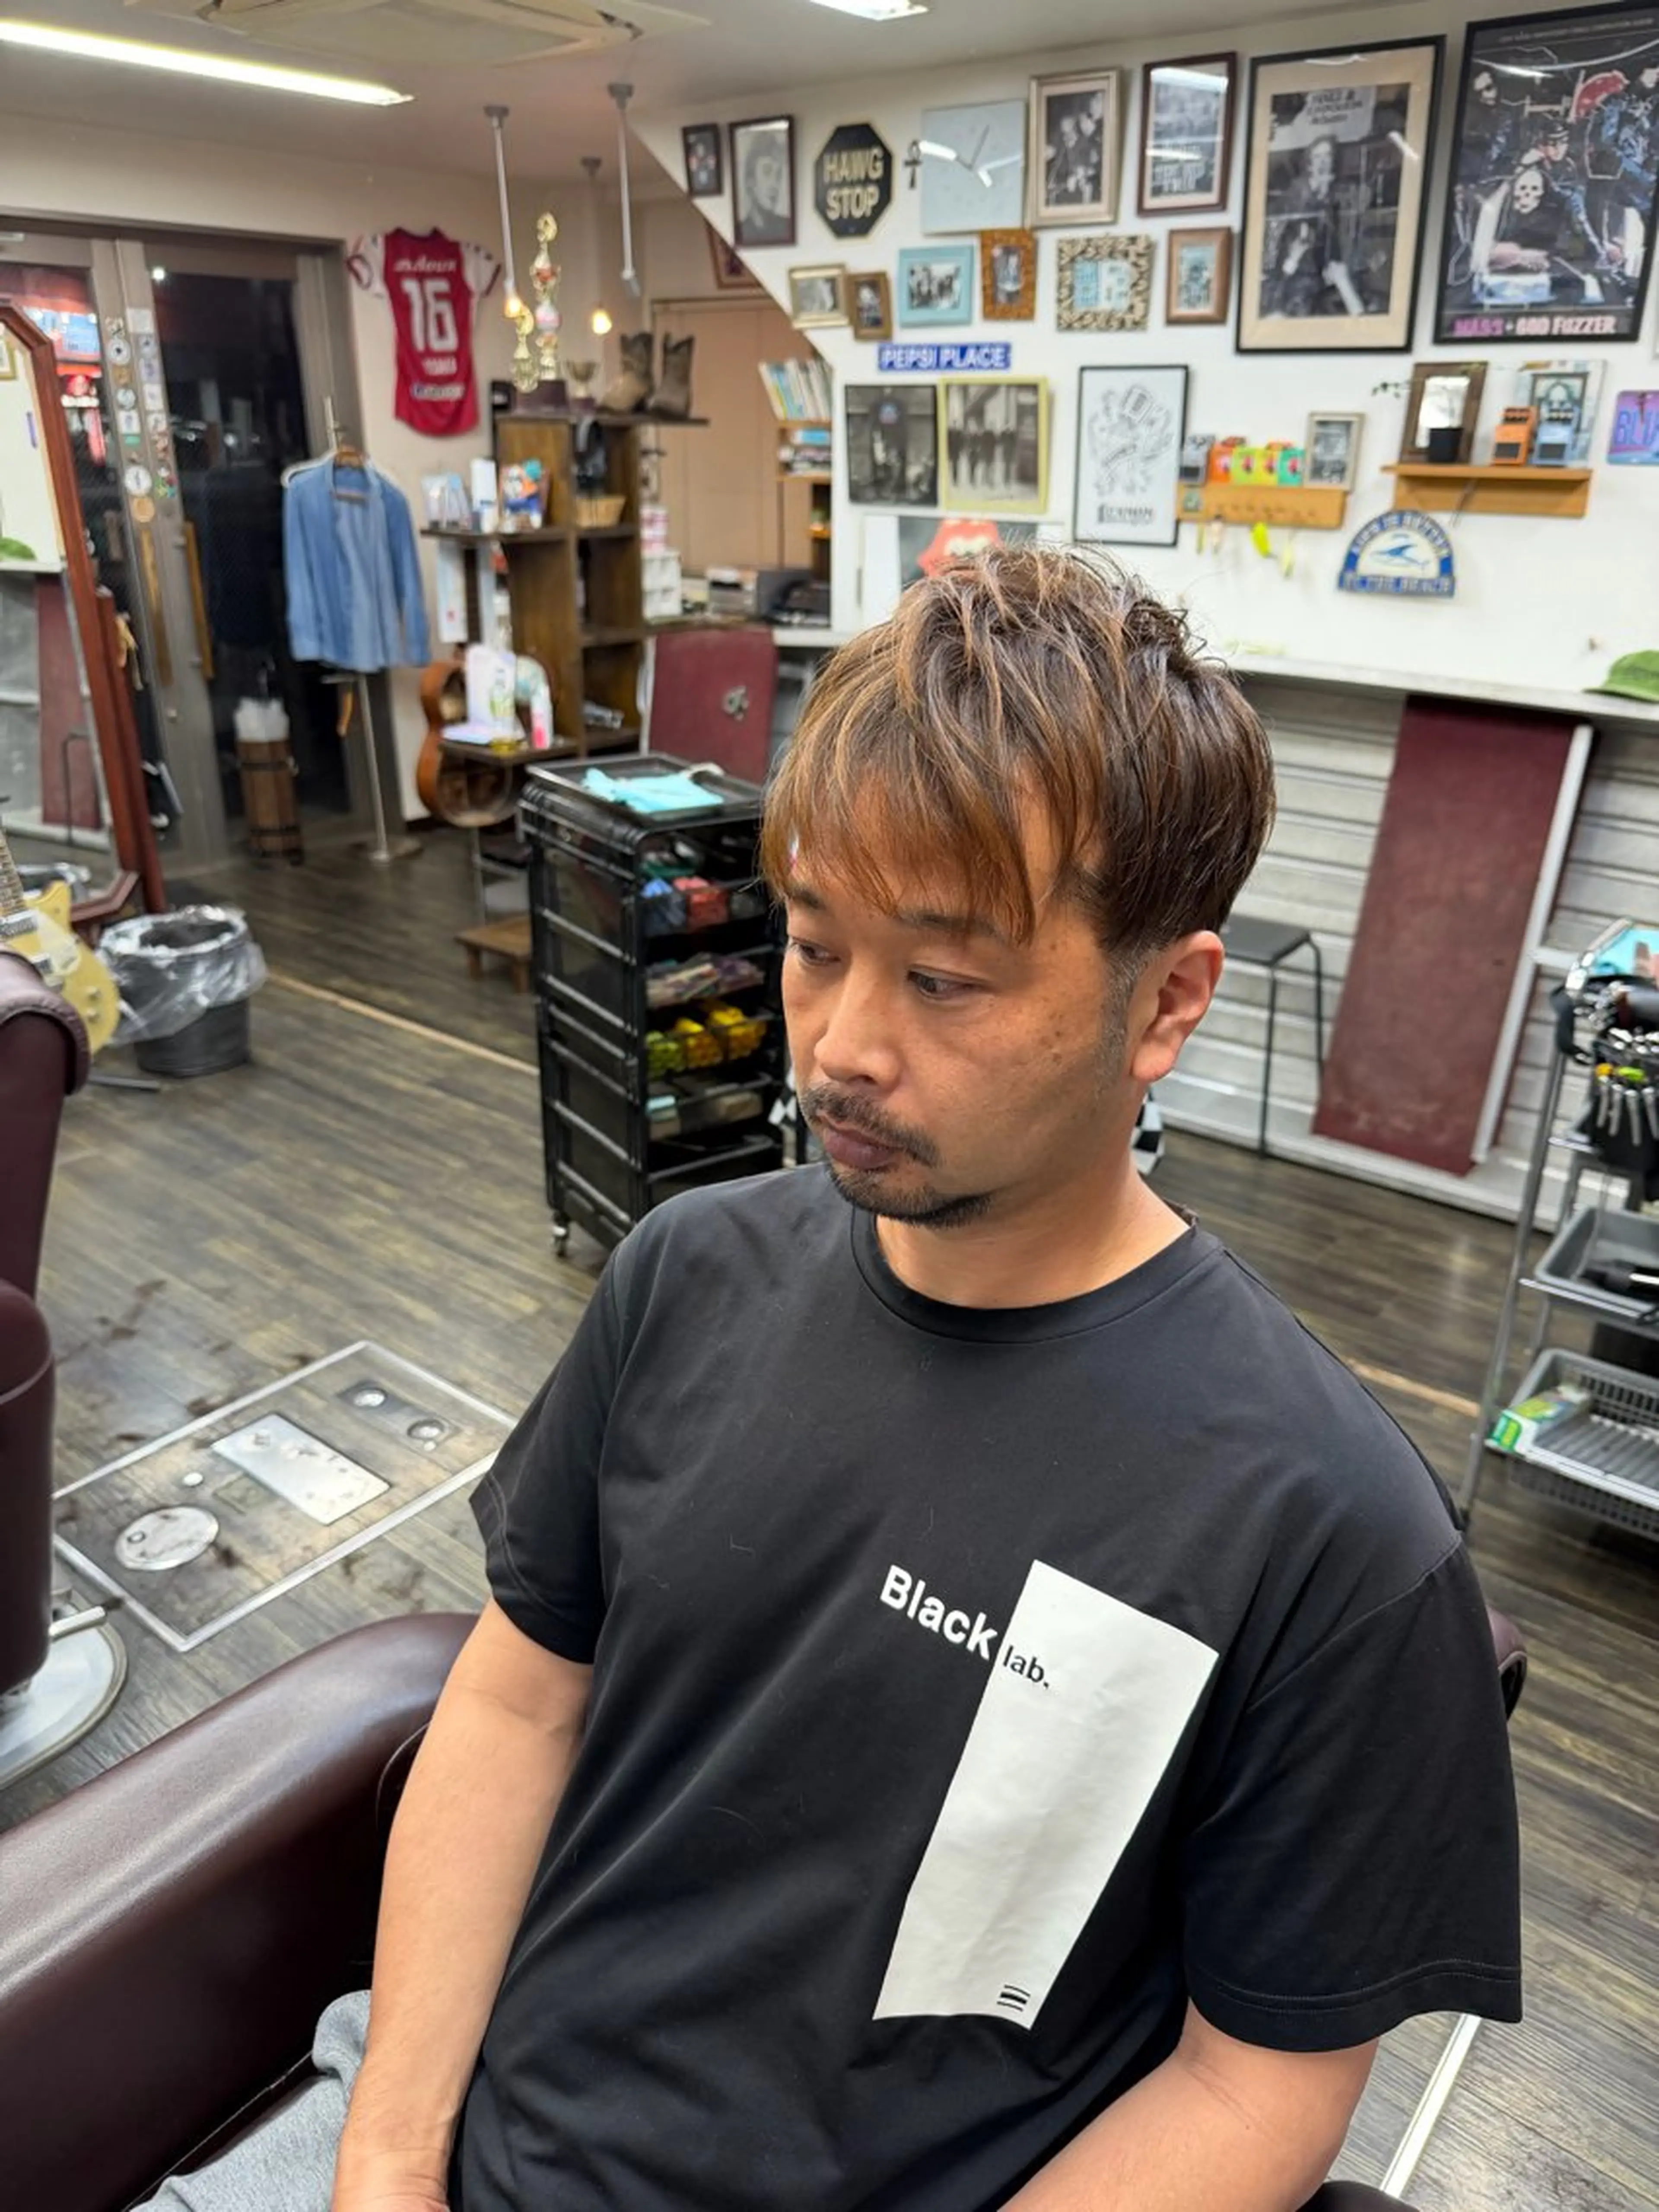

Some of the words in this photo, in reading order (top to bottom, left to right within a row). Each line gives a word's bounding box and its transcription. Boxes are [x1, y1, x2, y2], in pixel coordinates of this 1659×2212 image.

[826, 185, 880, 220] STOP
[401, 278, 459, 353] 16
[882, 346, 938, 369] PEPSI
[940, 345, 1006, 369] PLACE
[880, 1564, 998, 1661] Black
[1002, 1644, 1050, 1690] lab.
